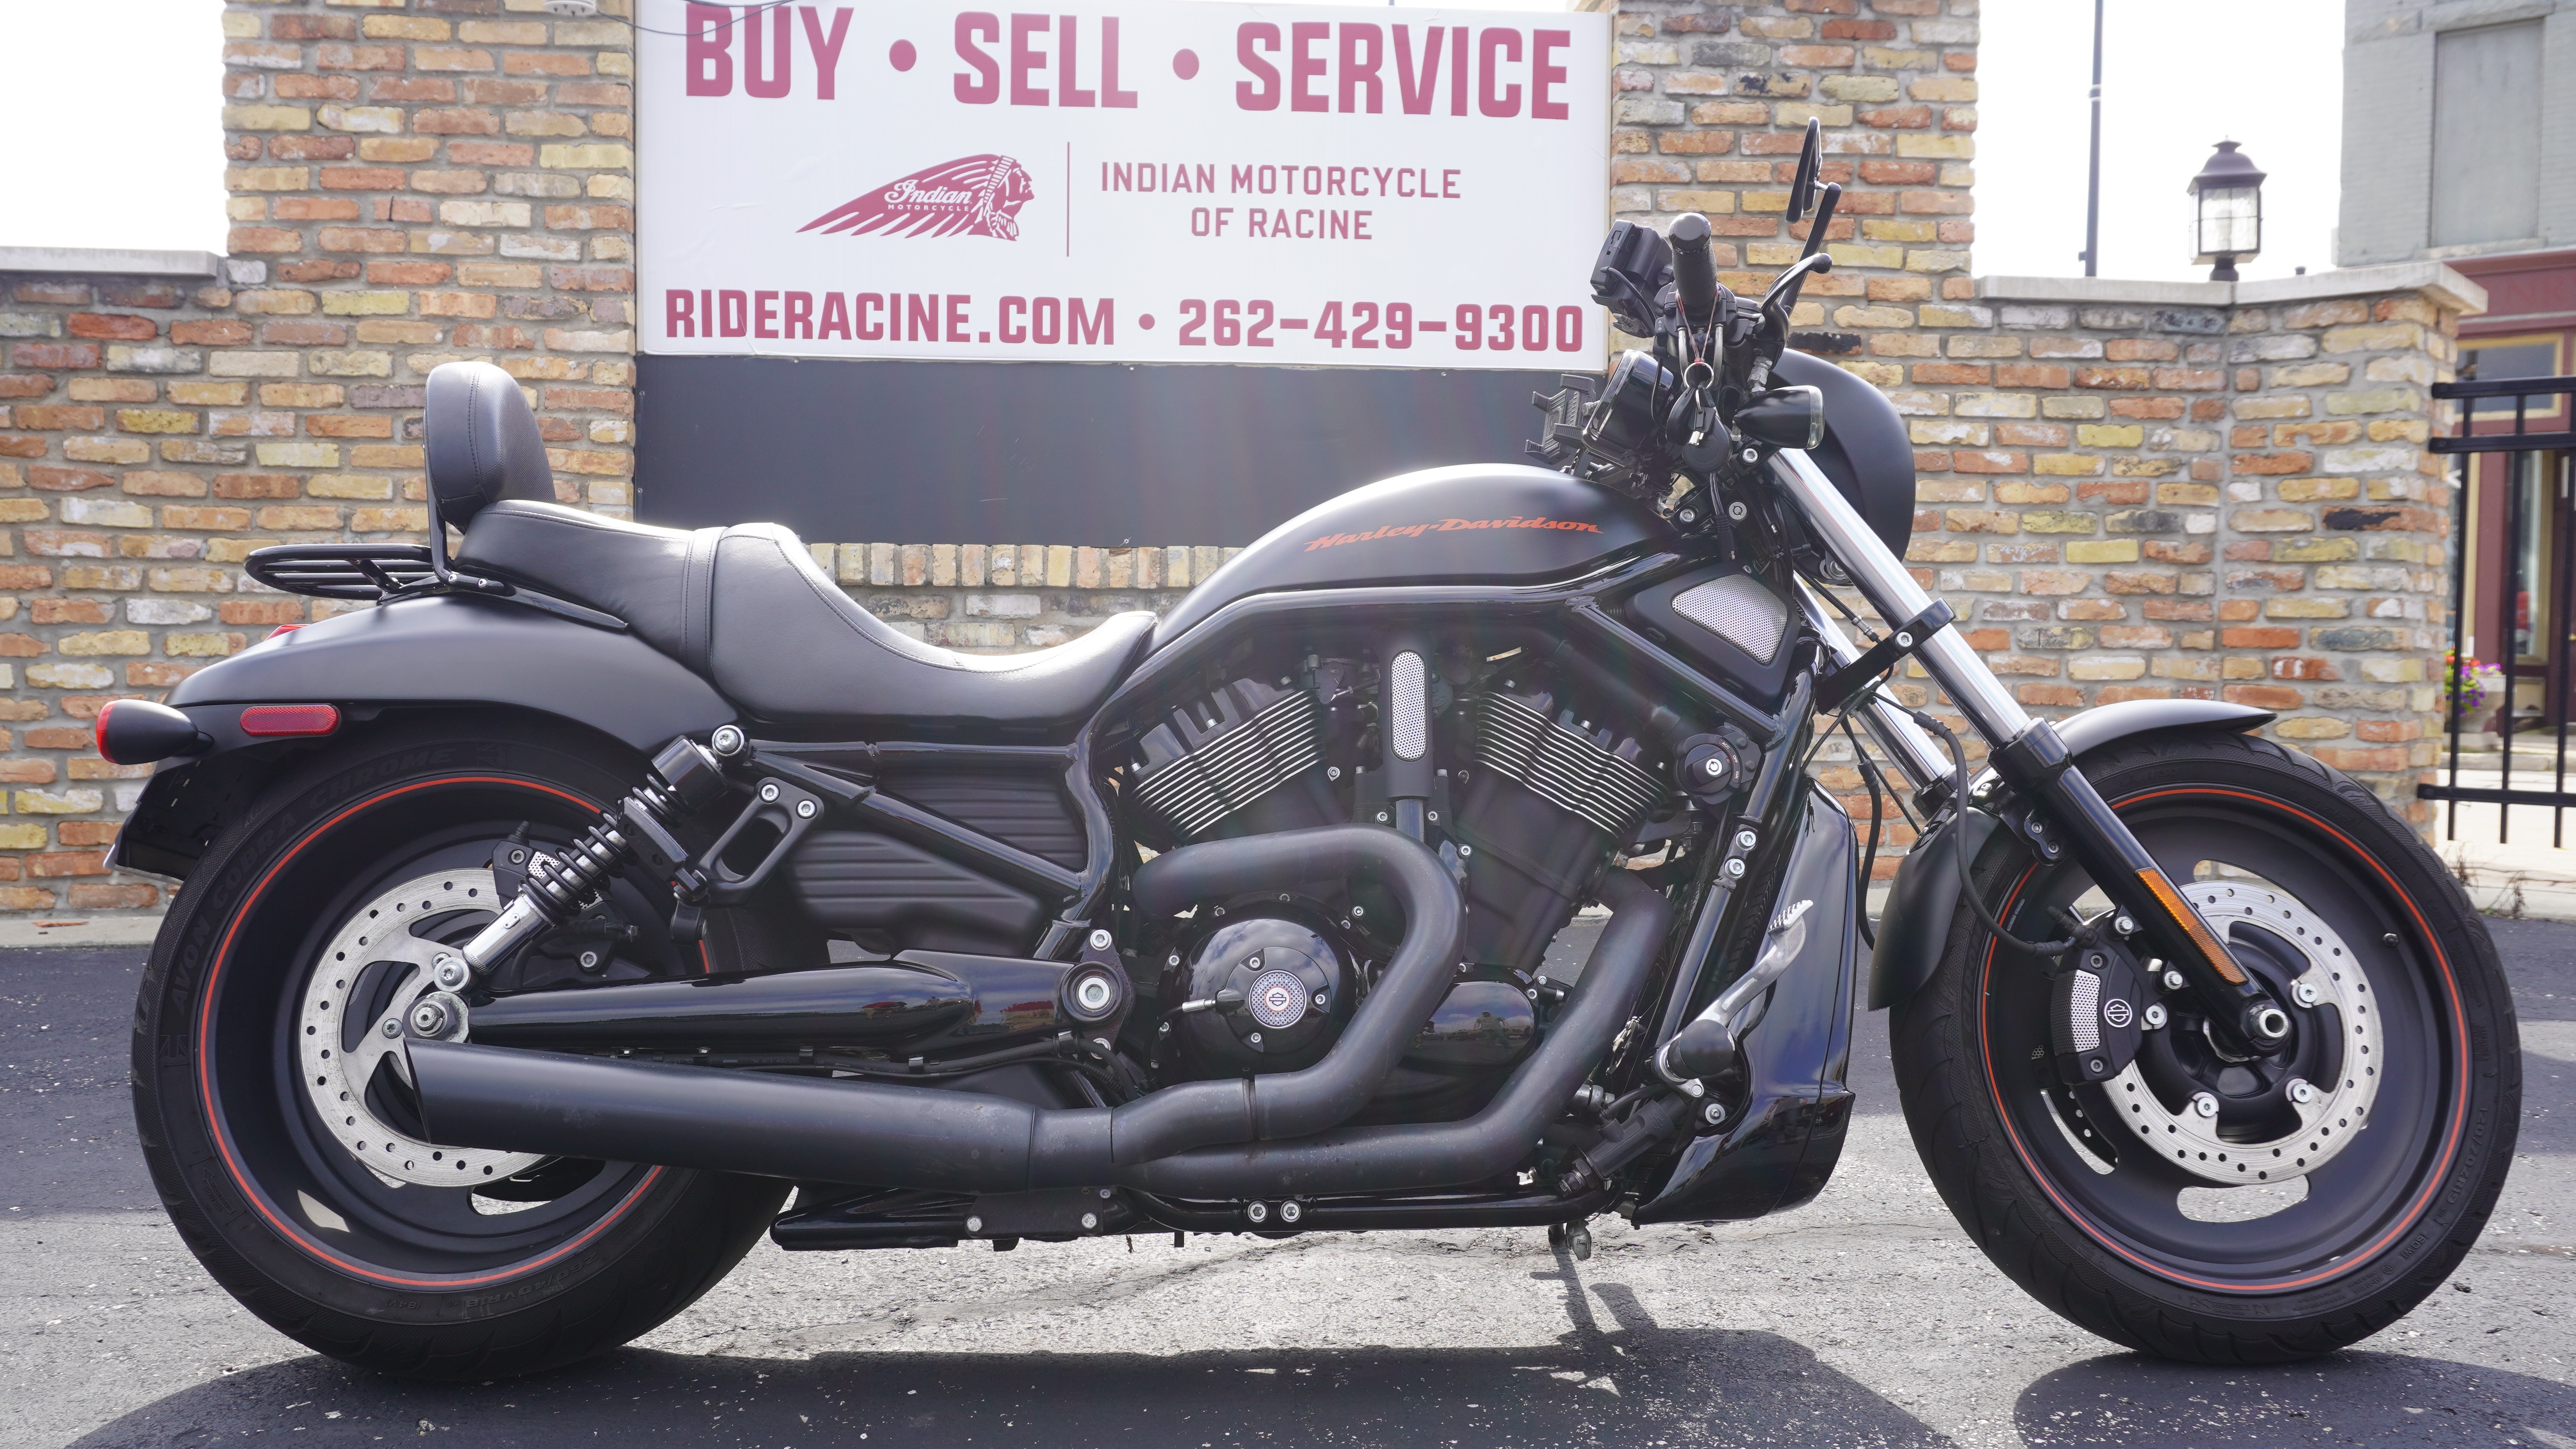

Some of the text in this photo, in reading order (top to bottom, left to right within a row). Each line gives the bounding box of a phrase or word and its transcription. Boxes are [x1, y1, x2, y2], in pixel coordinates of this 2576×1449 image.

[687, 3, 1570, 119] BUY SELL SERVICE
[884, 179, 972, 204] Indian
[1103, 164, 1460, 198] INDIAN MOTORCYCLE
[1192, 209, 1371, 239] OF RACINE
[666, 290, 1582, 352] RIDERACINE.COM 262-429-9300
[1303, 516, 1604, 552] Harley-Davidson
[172, 749, 456, 1016] AVON COBRA CHROME
